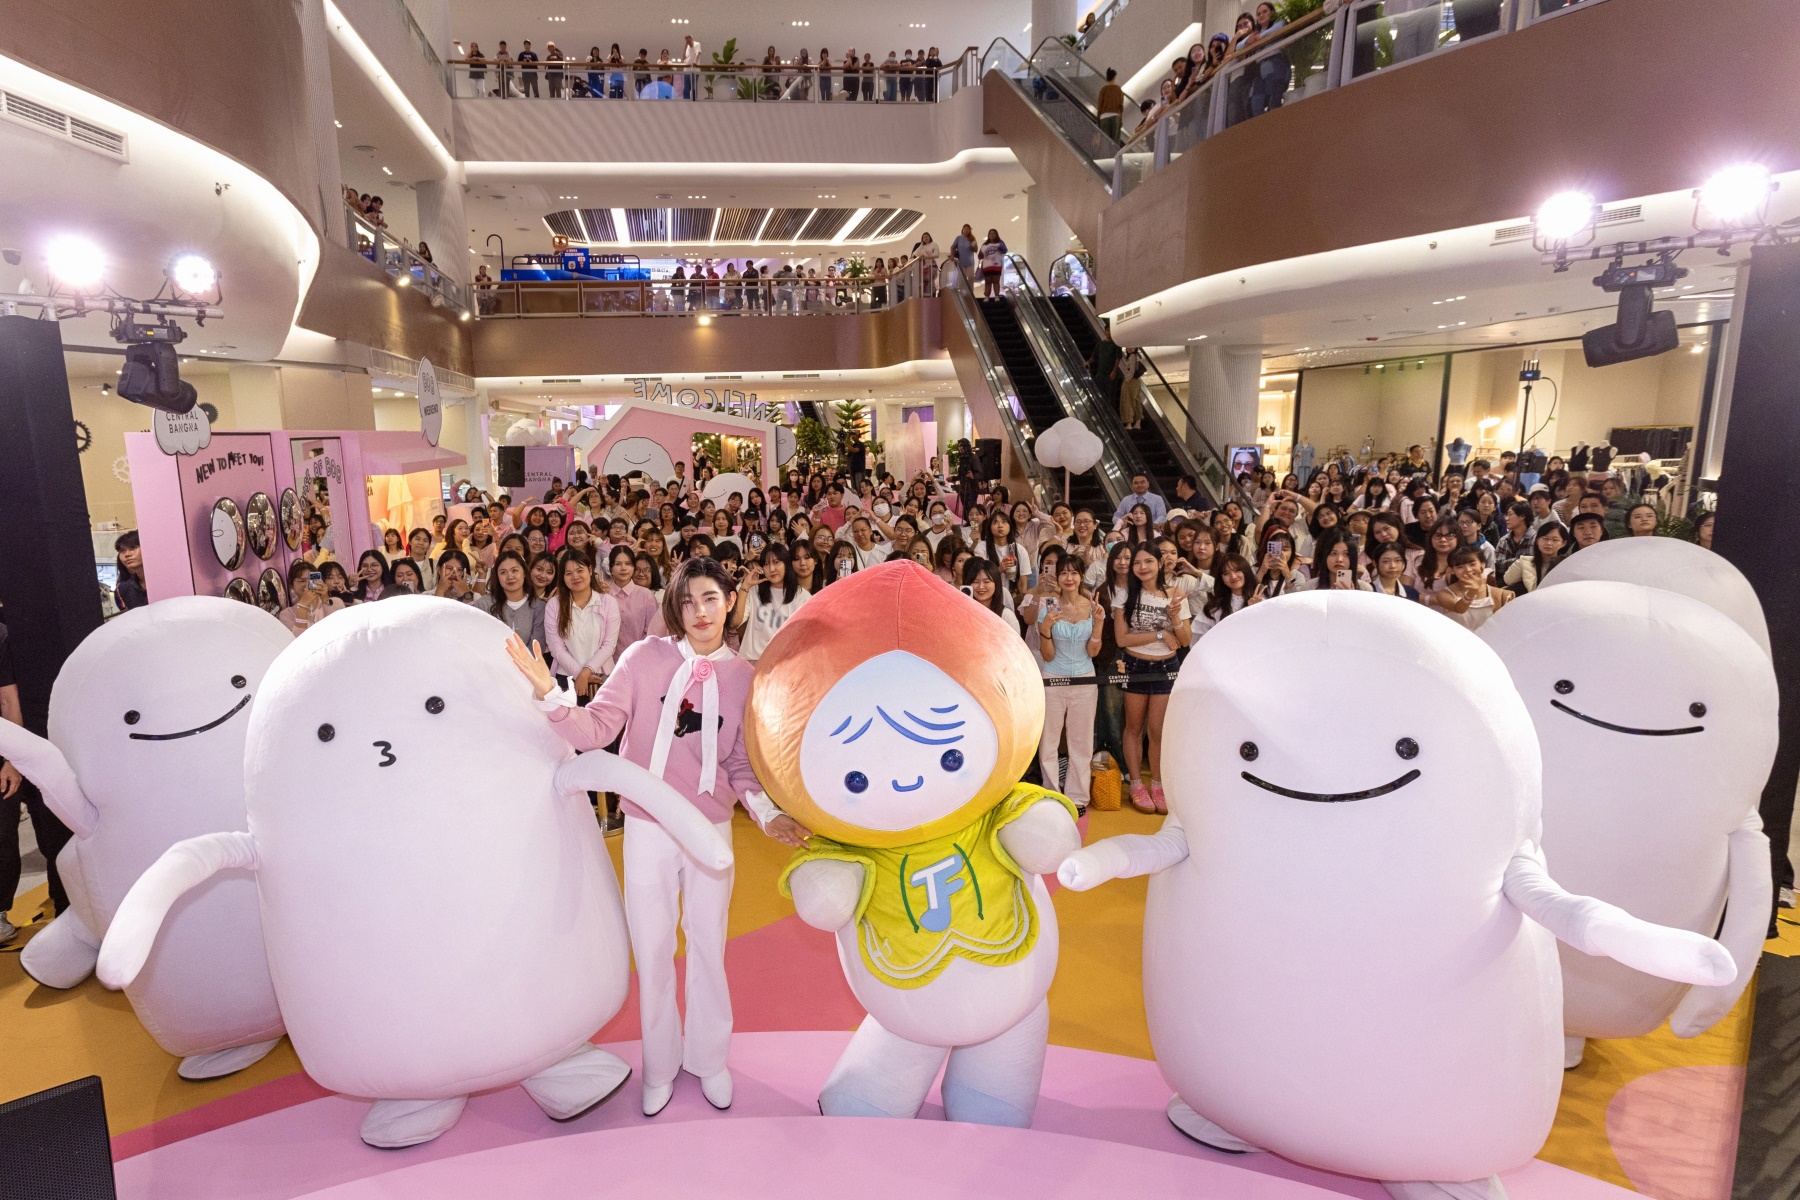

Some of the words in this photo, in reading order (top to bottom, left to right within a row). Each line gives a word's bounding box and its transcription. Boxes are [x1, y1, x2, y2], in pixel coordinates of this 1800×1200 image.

[168, 423, 199, 434] BANGNA
[196, 458, 215, 484] NEW
[216, 458, 227, 471] TO
[227, 451, 246, 469] MEET
[249, 453, 264, 472] YOU!
[300, 468, 312, 511] OUSE
[313, 459, 323, 478] OF
[325, 456, 342, 484] BOB
